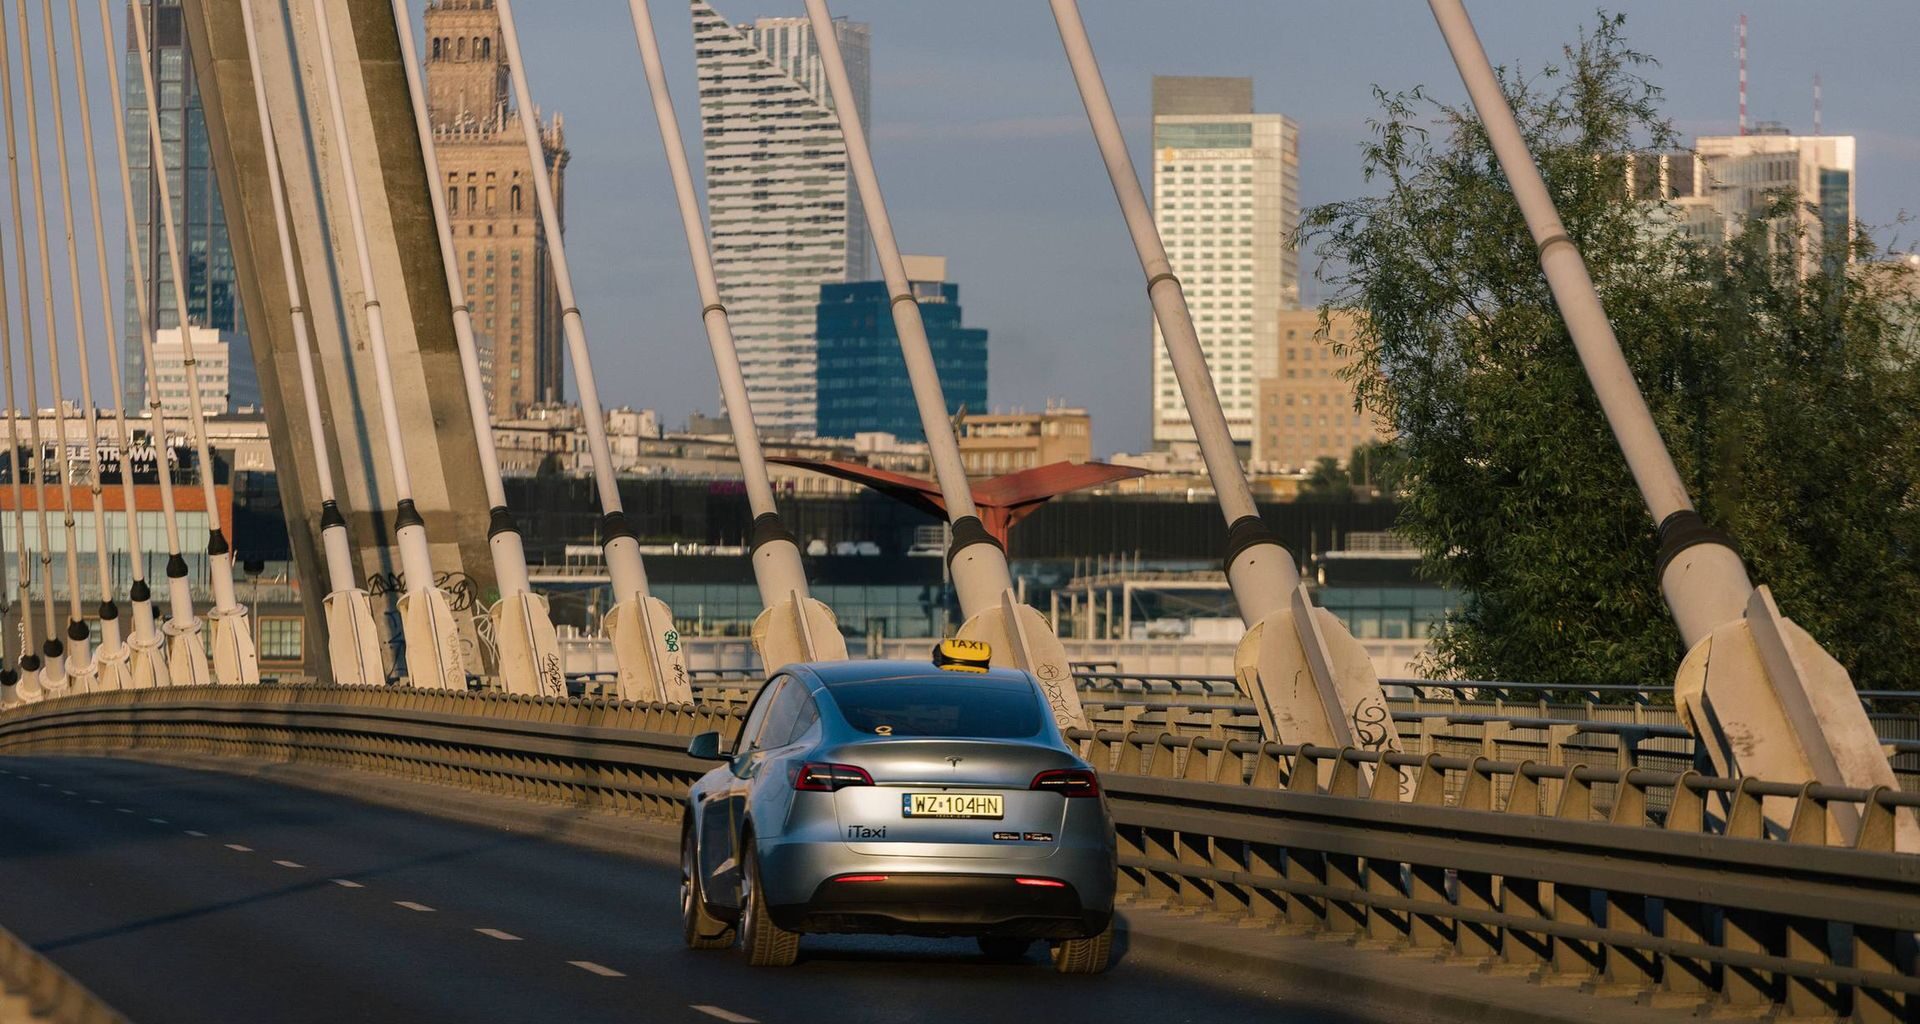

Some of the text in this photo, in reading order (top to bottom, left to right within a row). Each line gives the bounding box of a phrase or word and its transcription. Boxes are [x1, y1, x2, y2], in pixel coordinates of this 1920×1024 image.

[950, 639, 983, 651] TAXI
[915, 796, 998, 814] WZ 104HN
[848, 824, 887, 839] iTaxi
